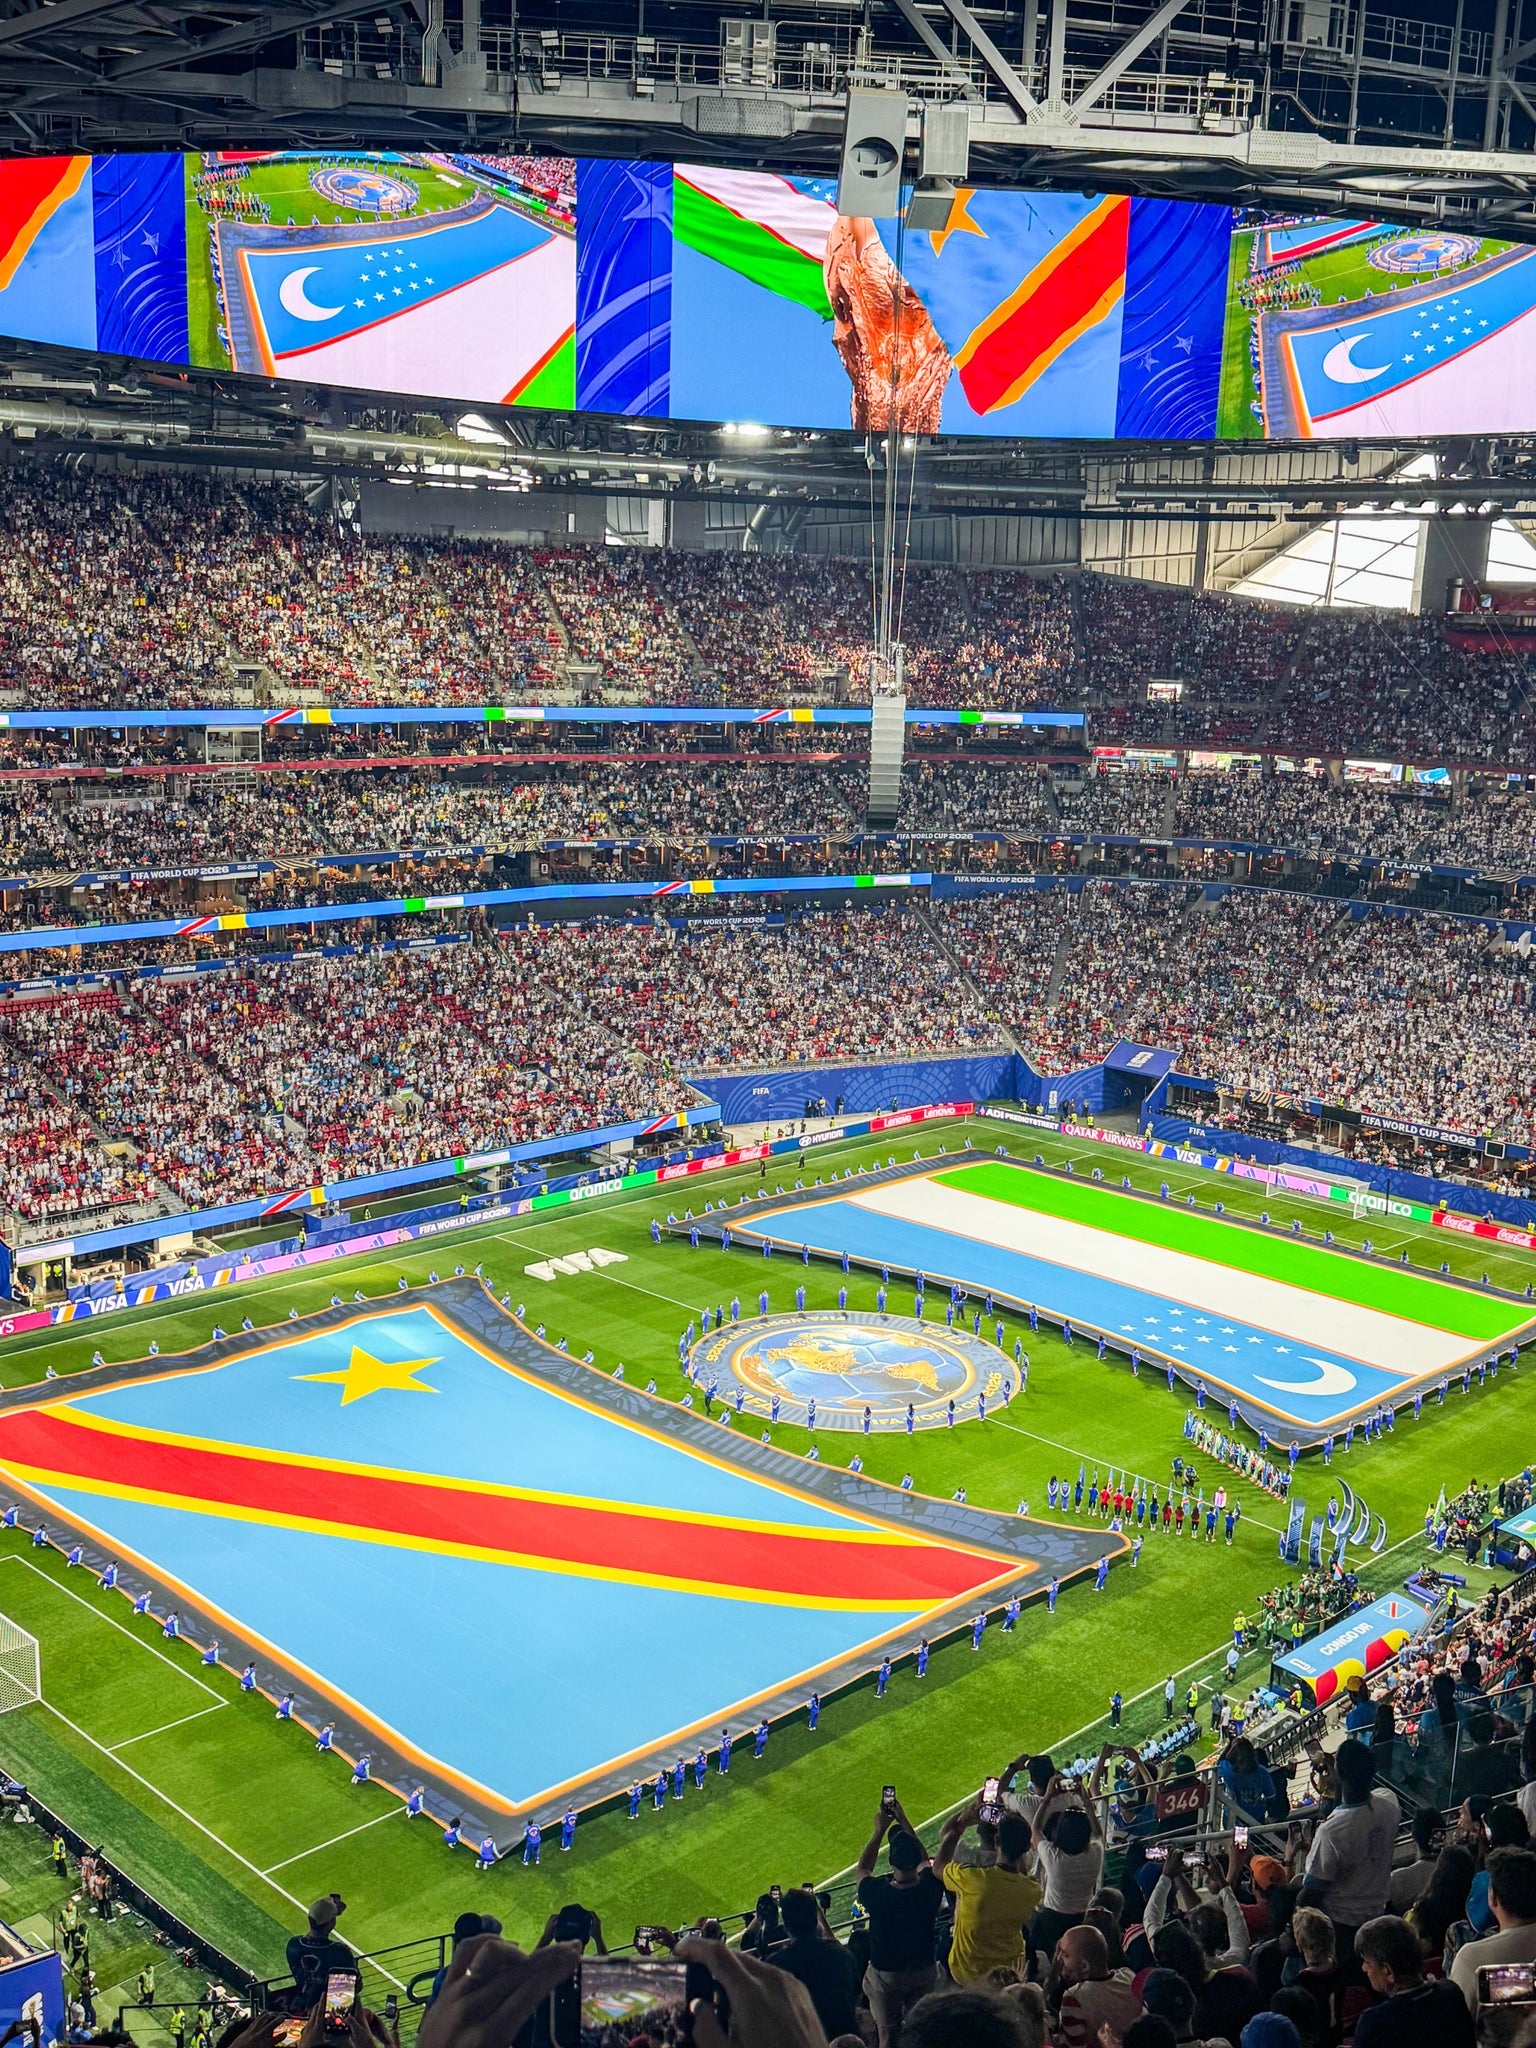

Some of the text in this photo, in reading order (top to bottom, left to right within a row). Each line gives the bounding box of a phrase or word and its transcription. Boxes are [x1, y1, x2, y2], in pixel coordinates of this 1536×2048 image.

[737, 836, 786, 844] ATLANTA
[423, 848, 473, 858] ATLANTA
[131, 872, 150, 881] FIFA
[151, 870, 182, 880] WORLD
[183, 868, 200, 878] CUP
[200, 866, 230, 875] 2026
[1380, 860, 1433, 873] ATLANTA
[752, 1087, 770, 1096] FIFA
[884, 1106, 956, 1129] Lenovo Lenovo
[812, 1128, 844, 1144] HYUNDAI
[1065, 1123, 1143, 1150] QATAR AIRWAYS
[1189, 1126, 1206, 1137] FIFA
[1360, 1114, 1477, 1147] FIFA WORLD CUP 2026
[1175, 1149, 1202, 1166] VISA
[569, 1178, 623, 1202] aramco
[1349, 1191, 1413, 1217] aramco
[419, 1222, 436, 1236] FIFA
[437, 1215, 465, 1230] WORLD
[466, 1211, 482, 1224] CUP
[524, 1247, 629, 1282] FIFA
[88, 1275, 205, 1315] VISA VISA
[923, 1326, 971, 1346] FIFA
[1319, 1621, 1375, 1657] CONGO DR
[1453, 1690, 1480, 1701] CONG
[1164, 1788, 1200, 1814] 346
